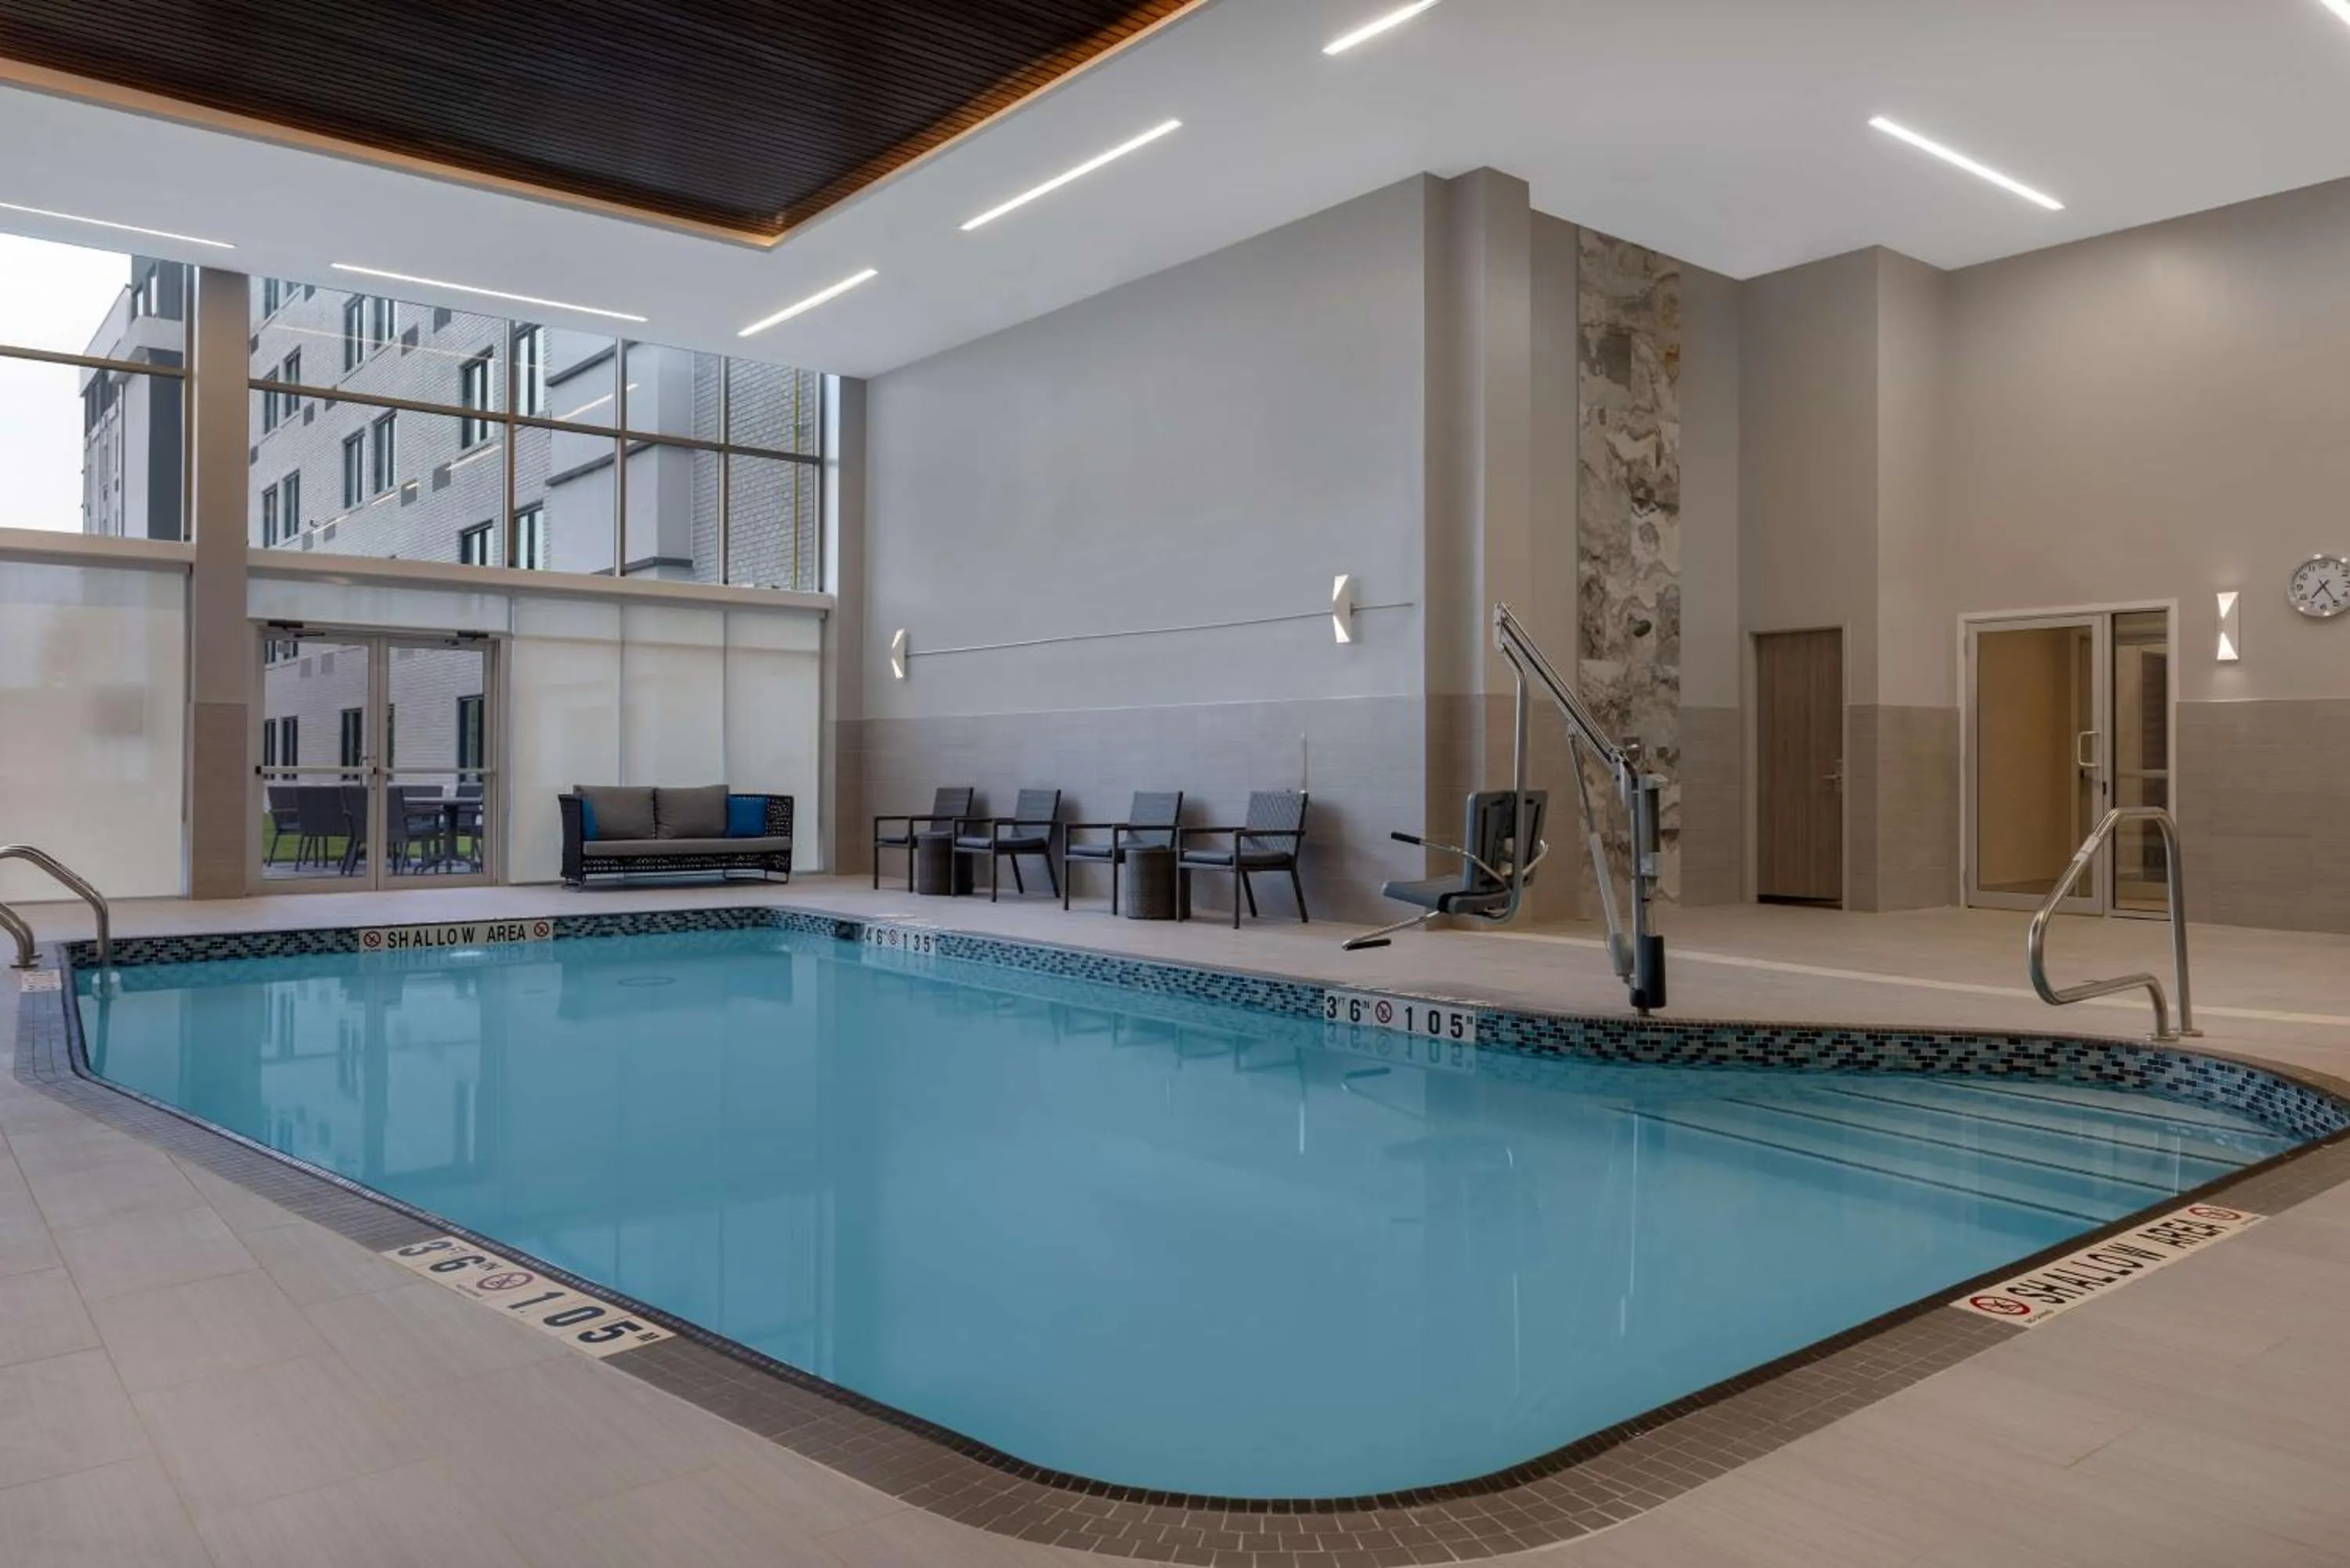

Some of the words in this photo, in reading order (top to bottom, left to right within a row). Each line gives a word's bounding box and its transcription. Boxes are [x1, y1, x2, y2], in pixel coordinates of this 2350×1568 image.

[387, 927, 475, 949] SHALLOW
[486, 924, 526, 943] AREA
[1326, 995, 1337, 1018] 3
[1350, 999, 1361, 1022] 6
[397, 1241, 454, 1257] 3
[428, 1255, 487, 1274] 6
[2005, 1241, 2168, 1305] SHALLOW
[2135, 1217, 2228, 1249] AREA
